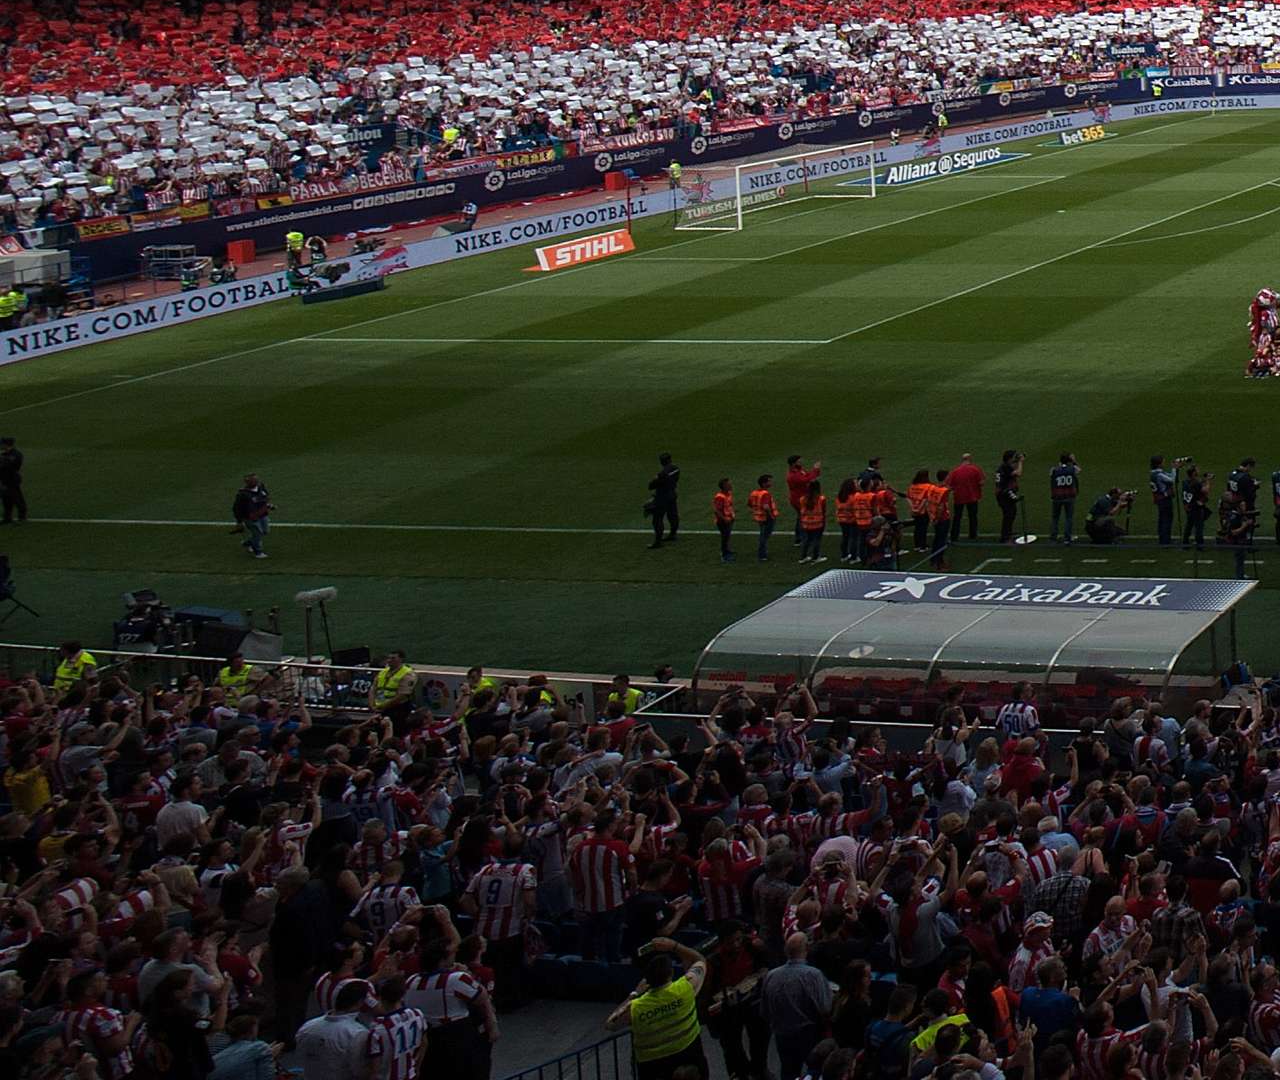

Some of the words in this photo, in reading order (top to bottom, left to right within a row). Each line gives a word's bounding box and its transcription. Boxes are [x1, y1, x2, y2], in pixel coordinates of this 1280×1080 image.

[1165, 77, 1211, 87] CaixaBank
[1134, 97, 1257, 116] NIKE.COM/FOOTBALL
[965, 118, 1073, 146] NIKE.COM/FOOTBALL
[1061, 125, 1105, 146] bet365
[750, 151, 888, 189] NIKE.COM/FOOTBALL
[886, 161, 937, 184] Allianz
[953, 147, 1001, 169] Seguros
[290, 182, 339, 201] PARLA
[360, 169, 414, 190] BECERRA
[455, 200, 648, 252] NIKE.COM/FOOTBALL
[555, 235, 625, 266] STIHL
[8, 278, 289, 356] NIKE.COM/FOOTBAL
[1055, 475, 1073, 487] 100
[938, 579, 1171, 607] CaixaBank
[1005, 714, 1020, 733] 50
[486, 879, 503, 905] 9
[639, 999, 683, 1022] COPRISE
[396, 1021, 418, 1054] 11
